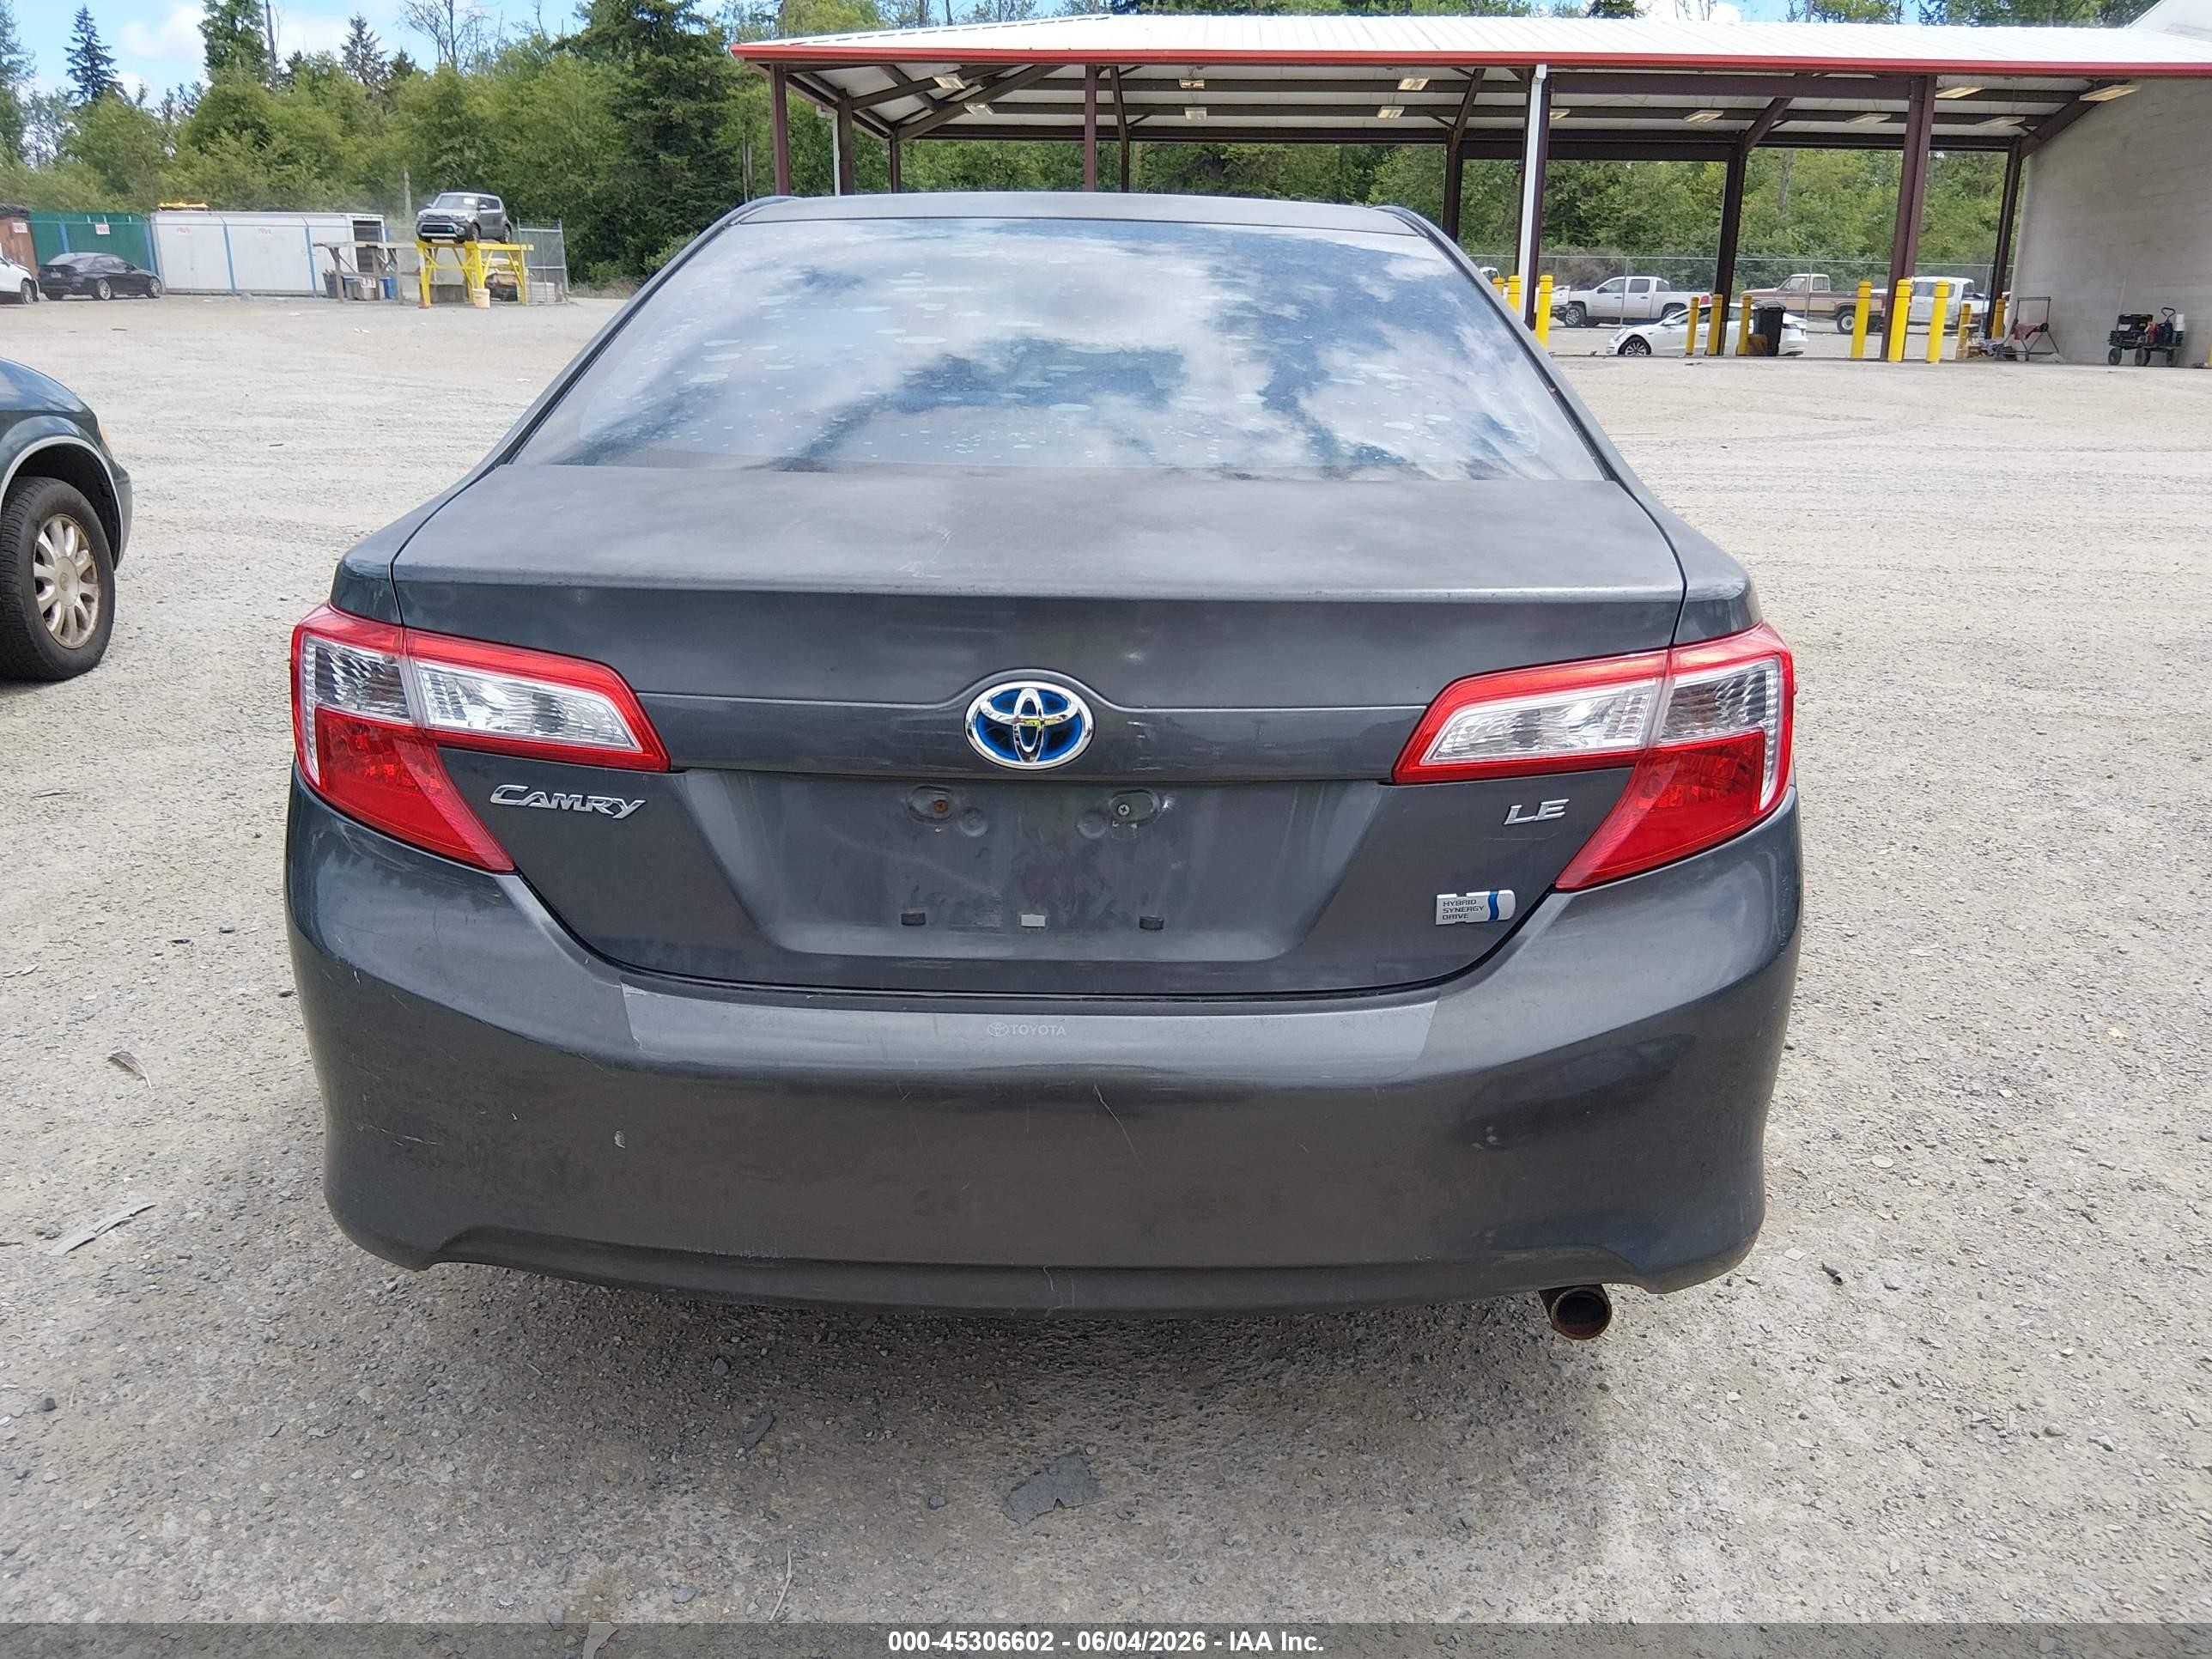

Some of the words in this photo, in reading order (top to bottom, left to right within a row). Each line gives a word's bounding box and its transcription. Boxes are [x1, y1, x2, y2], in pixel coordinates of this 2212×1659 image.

[490, 784, 646, 819] CAMRY
[1503, 799, 1570, 825] LE
[1443, 905, 1485, 914] SYNERGY
[1010, 1024, 1067, 1036] TOYOTA
